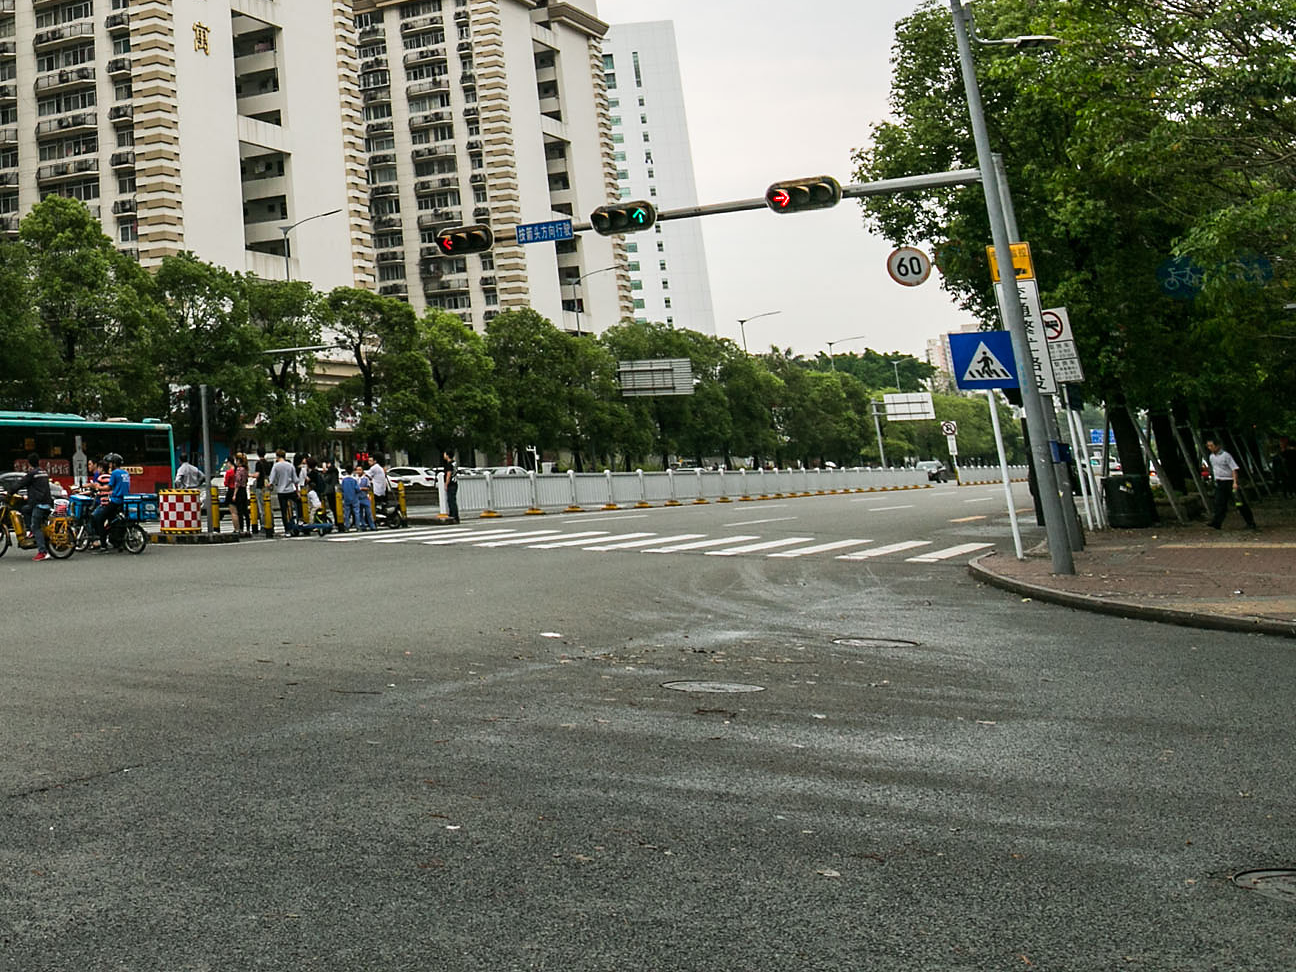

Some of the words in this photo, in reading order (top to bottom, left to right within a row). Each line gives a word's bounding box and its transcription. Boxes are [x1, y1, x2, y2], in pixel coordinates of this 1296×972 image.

[518, 222, 572, 242] 按箭头方向行驶
[896, 256, 922, 277] 60
